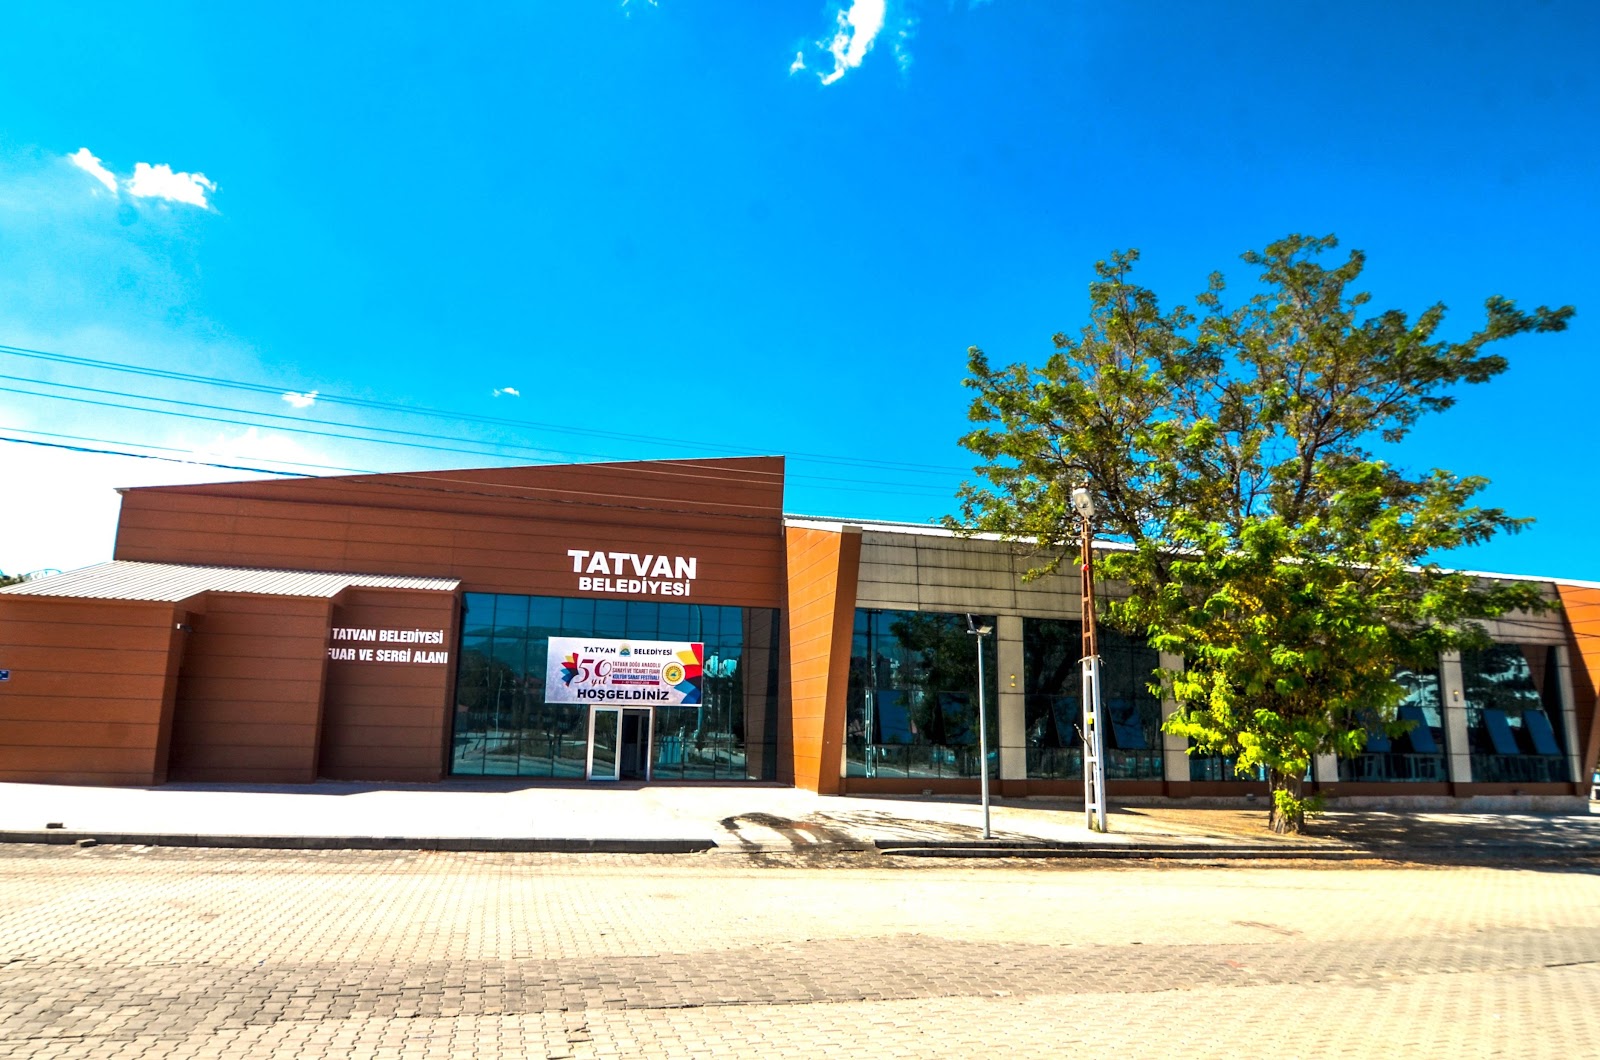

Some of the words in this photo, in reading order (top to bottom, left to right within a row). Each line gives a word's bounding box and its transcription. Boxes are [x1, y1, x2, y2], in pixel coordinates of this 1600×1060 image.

[567, 549, 697, 580] TATVAN
[578, 576, 691, 597] BELEDİYESİ
[332, 628, 377, 642] TATVAN
[379, 629, 444, 644] BELEDİYESİ
[359, 649, 374, 661] VE
[376, 648, 412, 663] SERGİ
[413, 651, 449, 664] ALANI
[584, 646, 616, 654] TATVAN
[634, 648, 672, 656] BELEDİYESİ
[577, 689, 669, 701] HOŞGELDİNİZ
